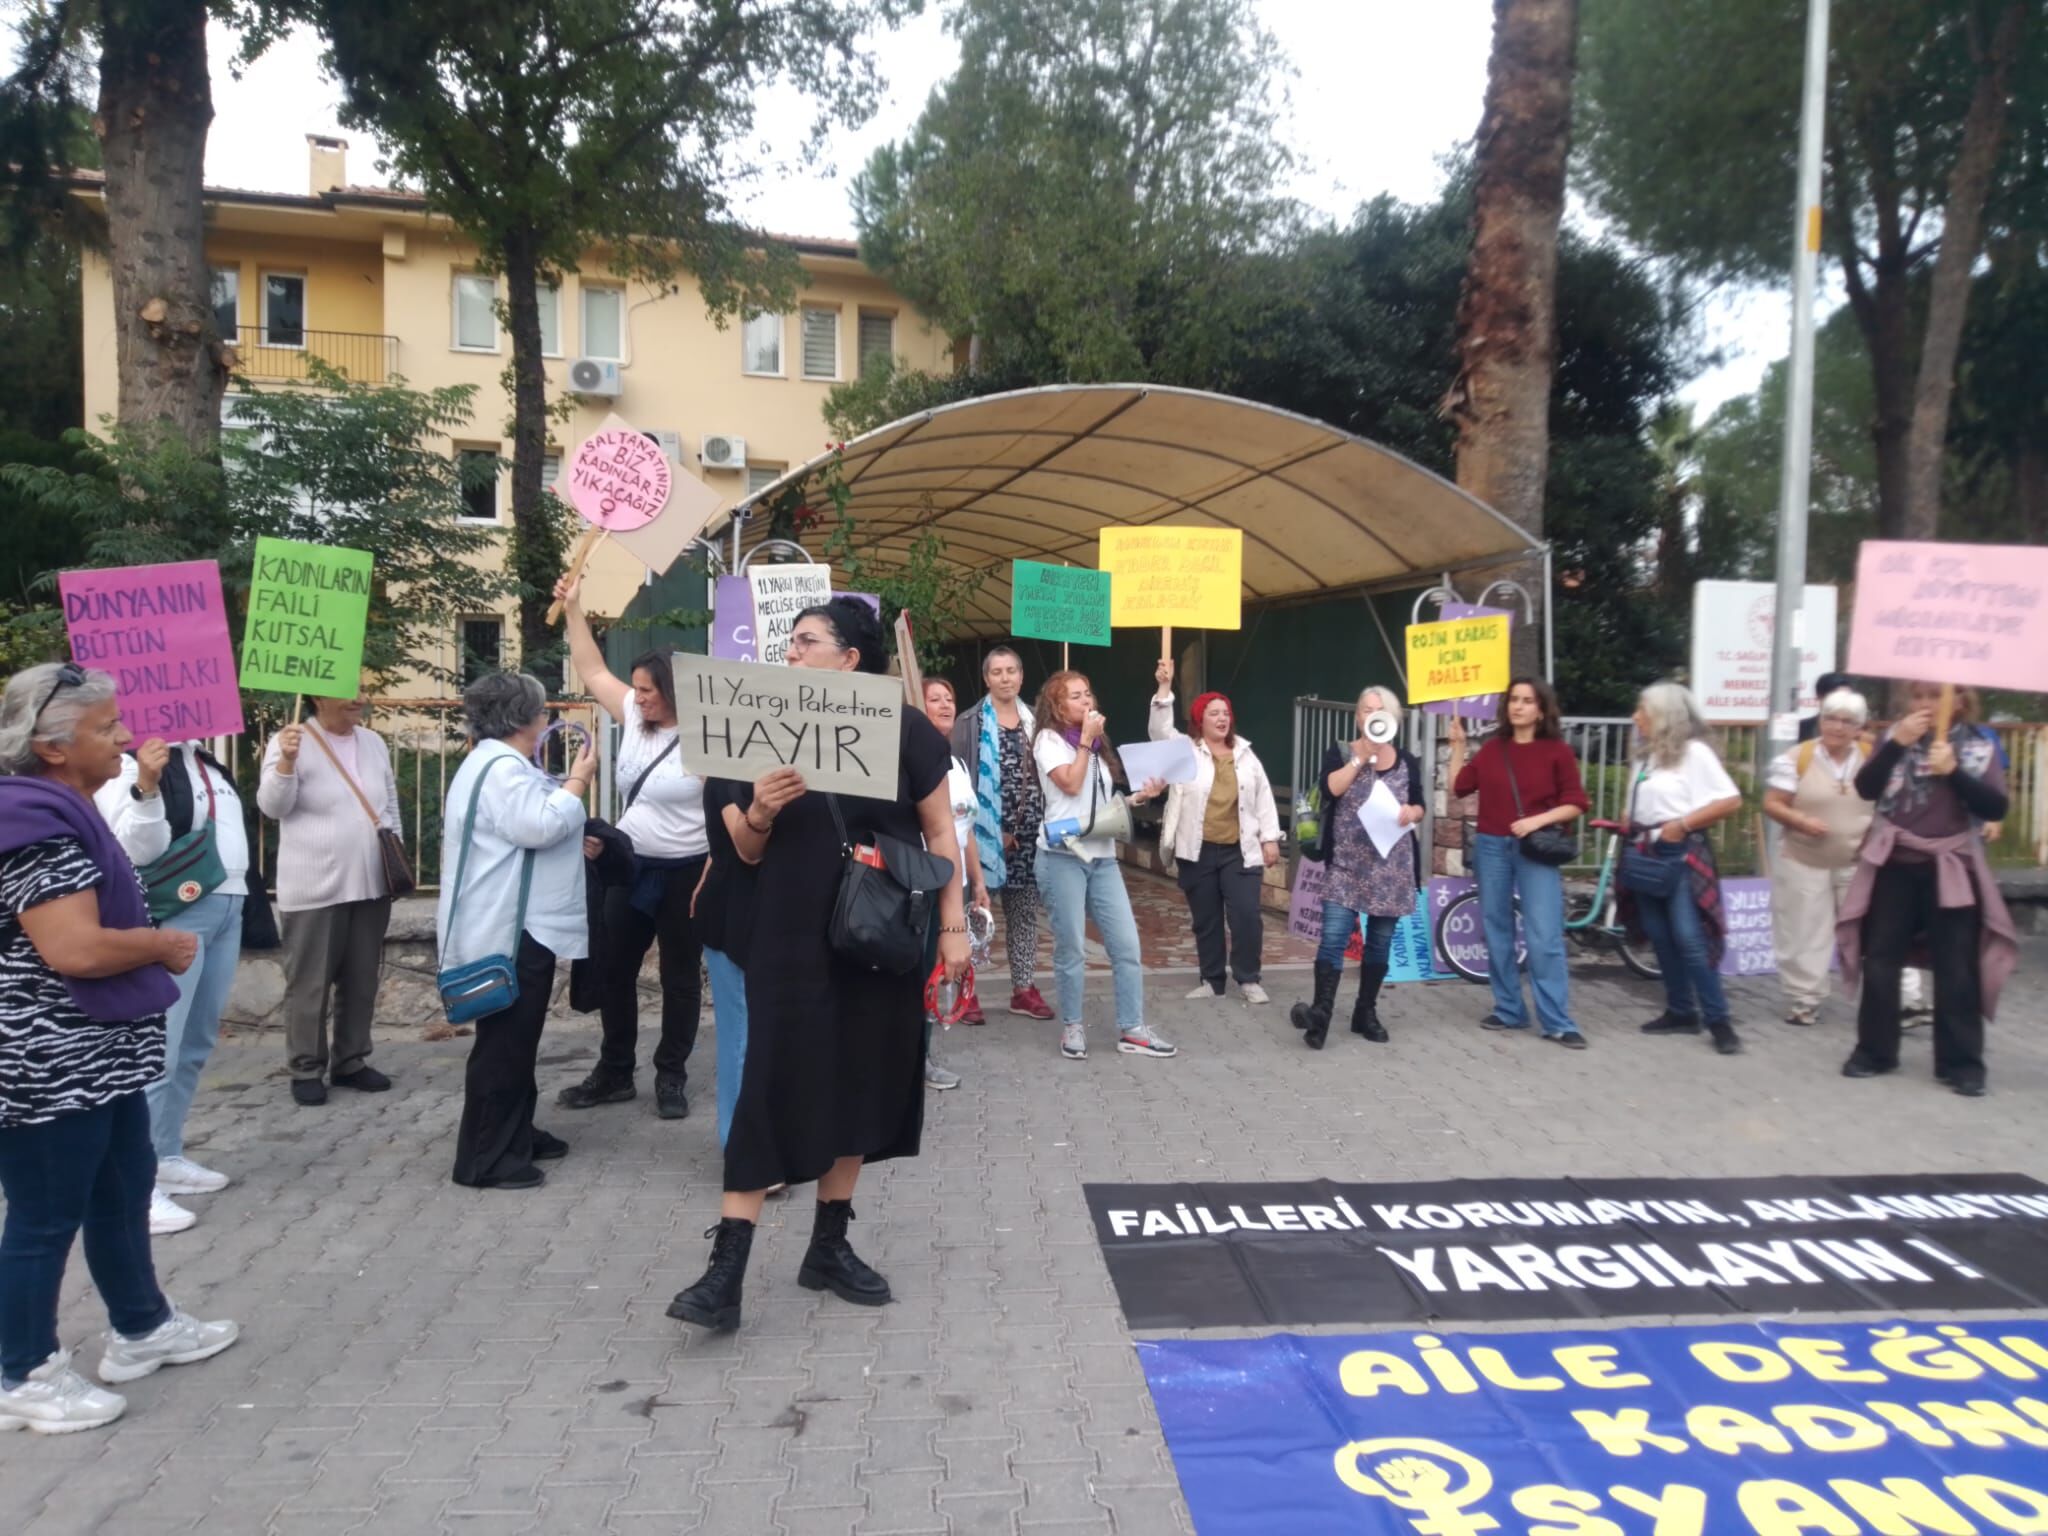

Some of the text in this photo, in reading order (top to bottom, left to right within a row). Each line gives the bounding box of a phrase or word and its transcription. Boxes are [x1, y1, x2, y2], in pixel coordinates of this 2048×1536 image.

[579, 453, 652, 495] KADINLAR
[612, 446, 646, 474] BİZ
[256, 554, 371, 596] KADINLARIN
[66, 580, 207, 623] DÜNYANIN
[256, 589, 320, 619] FAİLİ
[758, 596, 794, 616] MECLİSE
[72, 628, 166, 662] BÜTÜN
[251, 618, 344, 651] KUTSAL
[245, 649, 336, 682] AİLENİZ
[1428, 664, 1482, 687] ADALET
[799, 685, 893, 718] Paketine
[702, 715, 871, 777] HAYIR
[1107, 1194, 1367, 1237] FAİLLERİ
[1371, 1198, 1751, 1231] KORUMAYIN,
[1376, 1238, 1934, 1292] YARGILAYIN
[1339, 1334, 1652, 1397] AİLE
